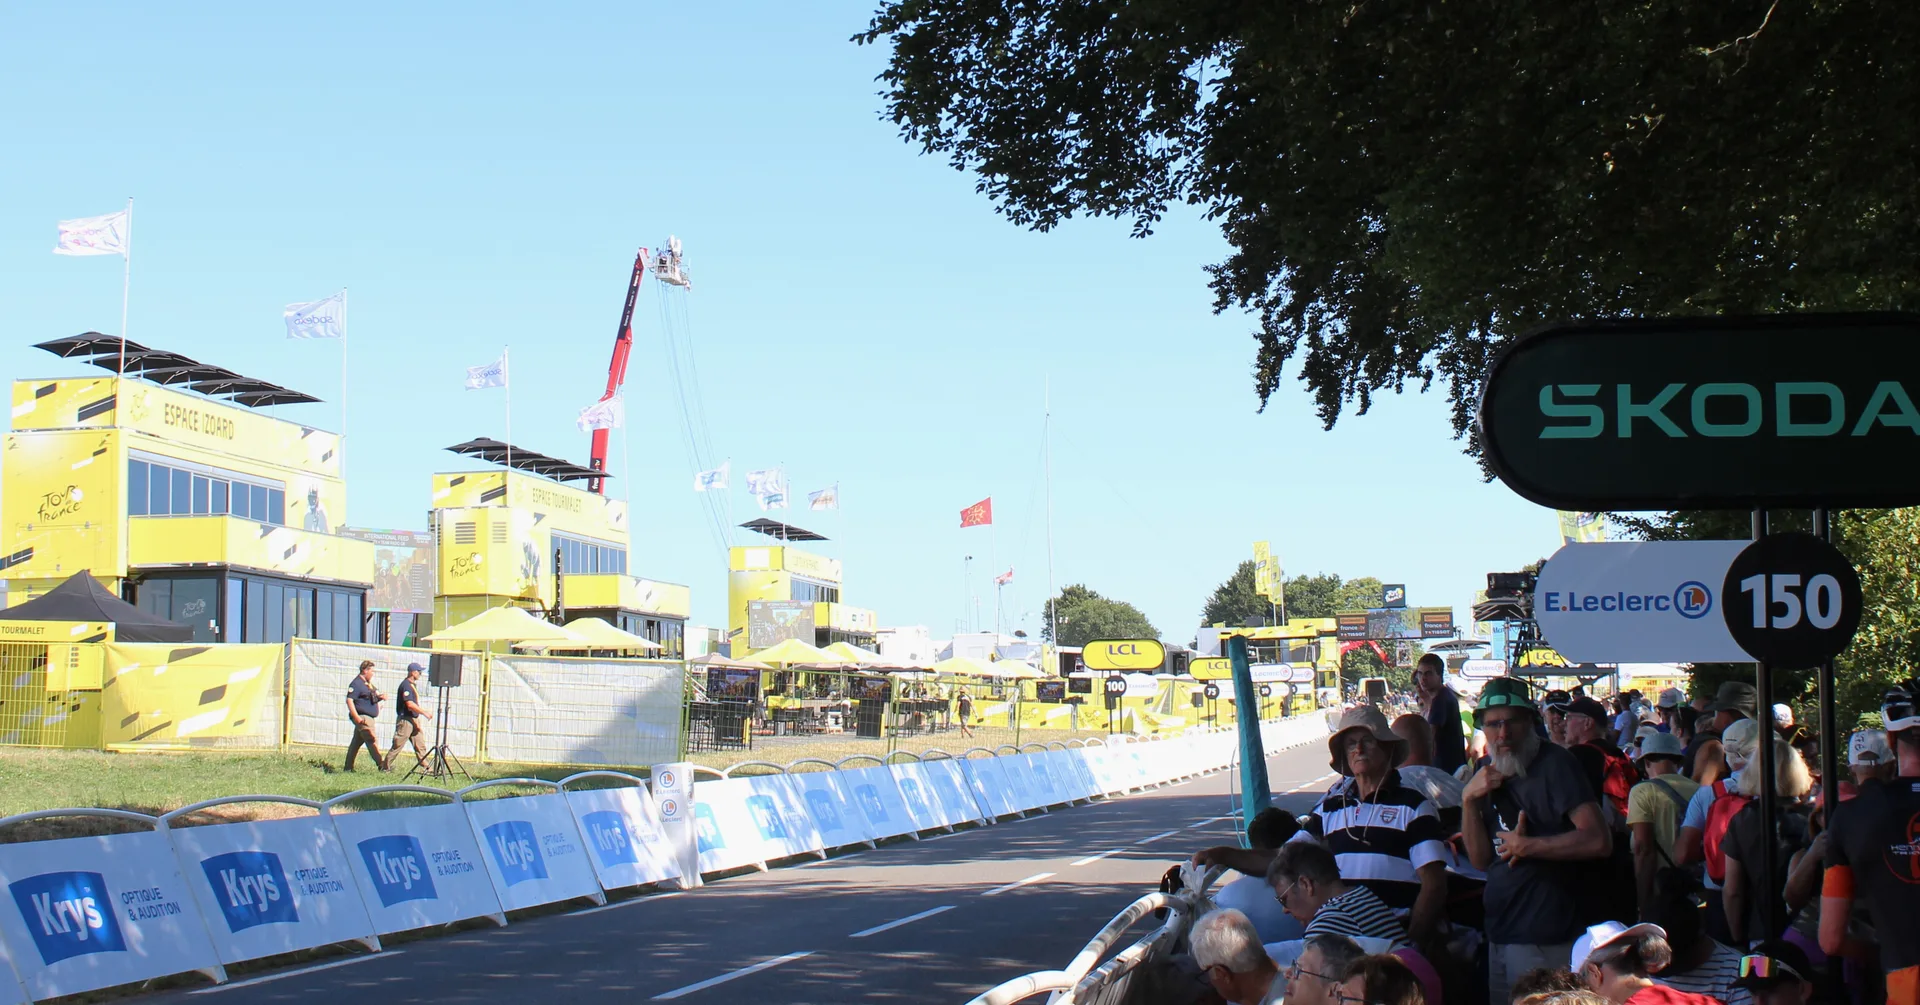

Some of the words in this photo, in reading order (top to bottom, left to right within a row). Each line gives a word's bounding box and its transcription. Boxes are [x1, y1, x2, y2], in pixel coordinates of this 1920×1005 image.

[164, 403, 198, 432] ESPACE
[202, 412, 234, 441] IZOARD
[1545, 591, 1670, 612] E.Leclerc
[1740, 573, 1843, 630] 150
[1, 626, 45, 635] TOURMALET
[1109, 644, 1142, 655] LCL
[1106, 681, 1125, 692] 100
[1207, 687, 1216, 696] 75
[592, 822, 626, 855] Krys
[431, 849, 461, 863] OPTIQUE
[495, 835, 535, 871] Krys
[294, 866, 329, 881] OPTIQUE
[372, 850, 422, 890] Krys
[444, 861, 475, 876] AUDITION
[121, 887, 163, 905] OPTIQUE
[219, 868, 280, 913] Krys
[309, 879, 345, 897] AUDITION
[31, 891, 104, 941] Krys
[128, 908, 138, 921] &
[139, 901, 181, 919] AUDITION
